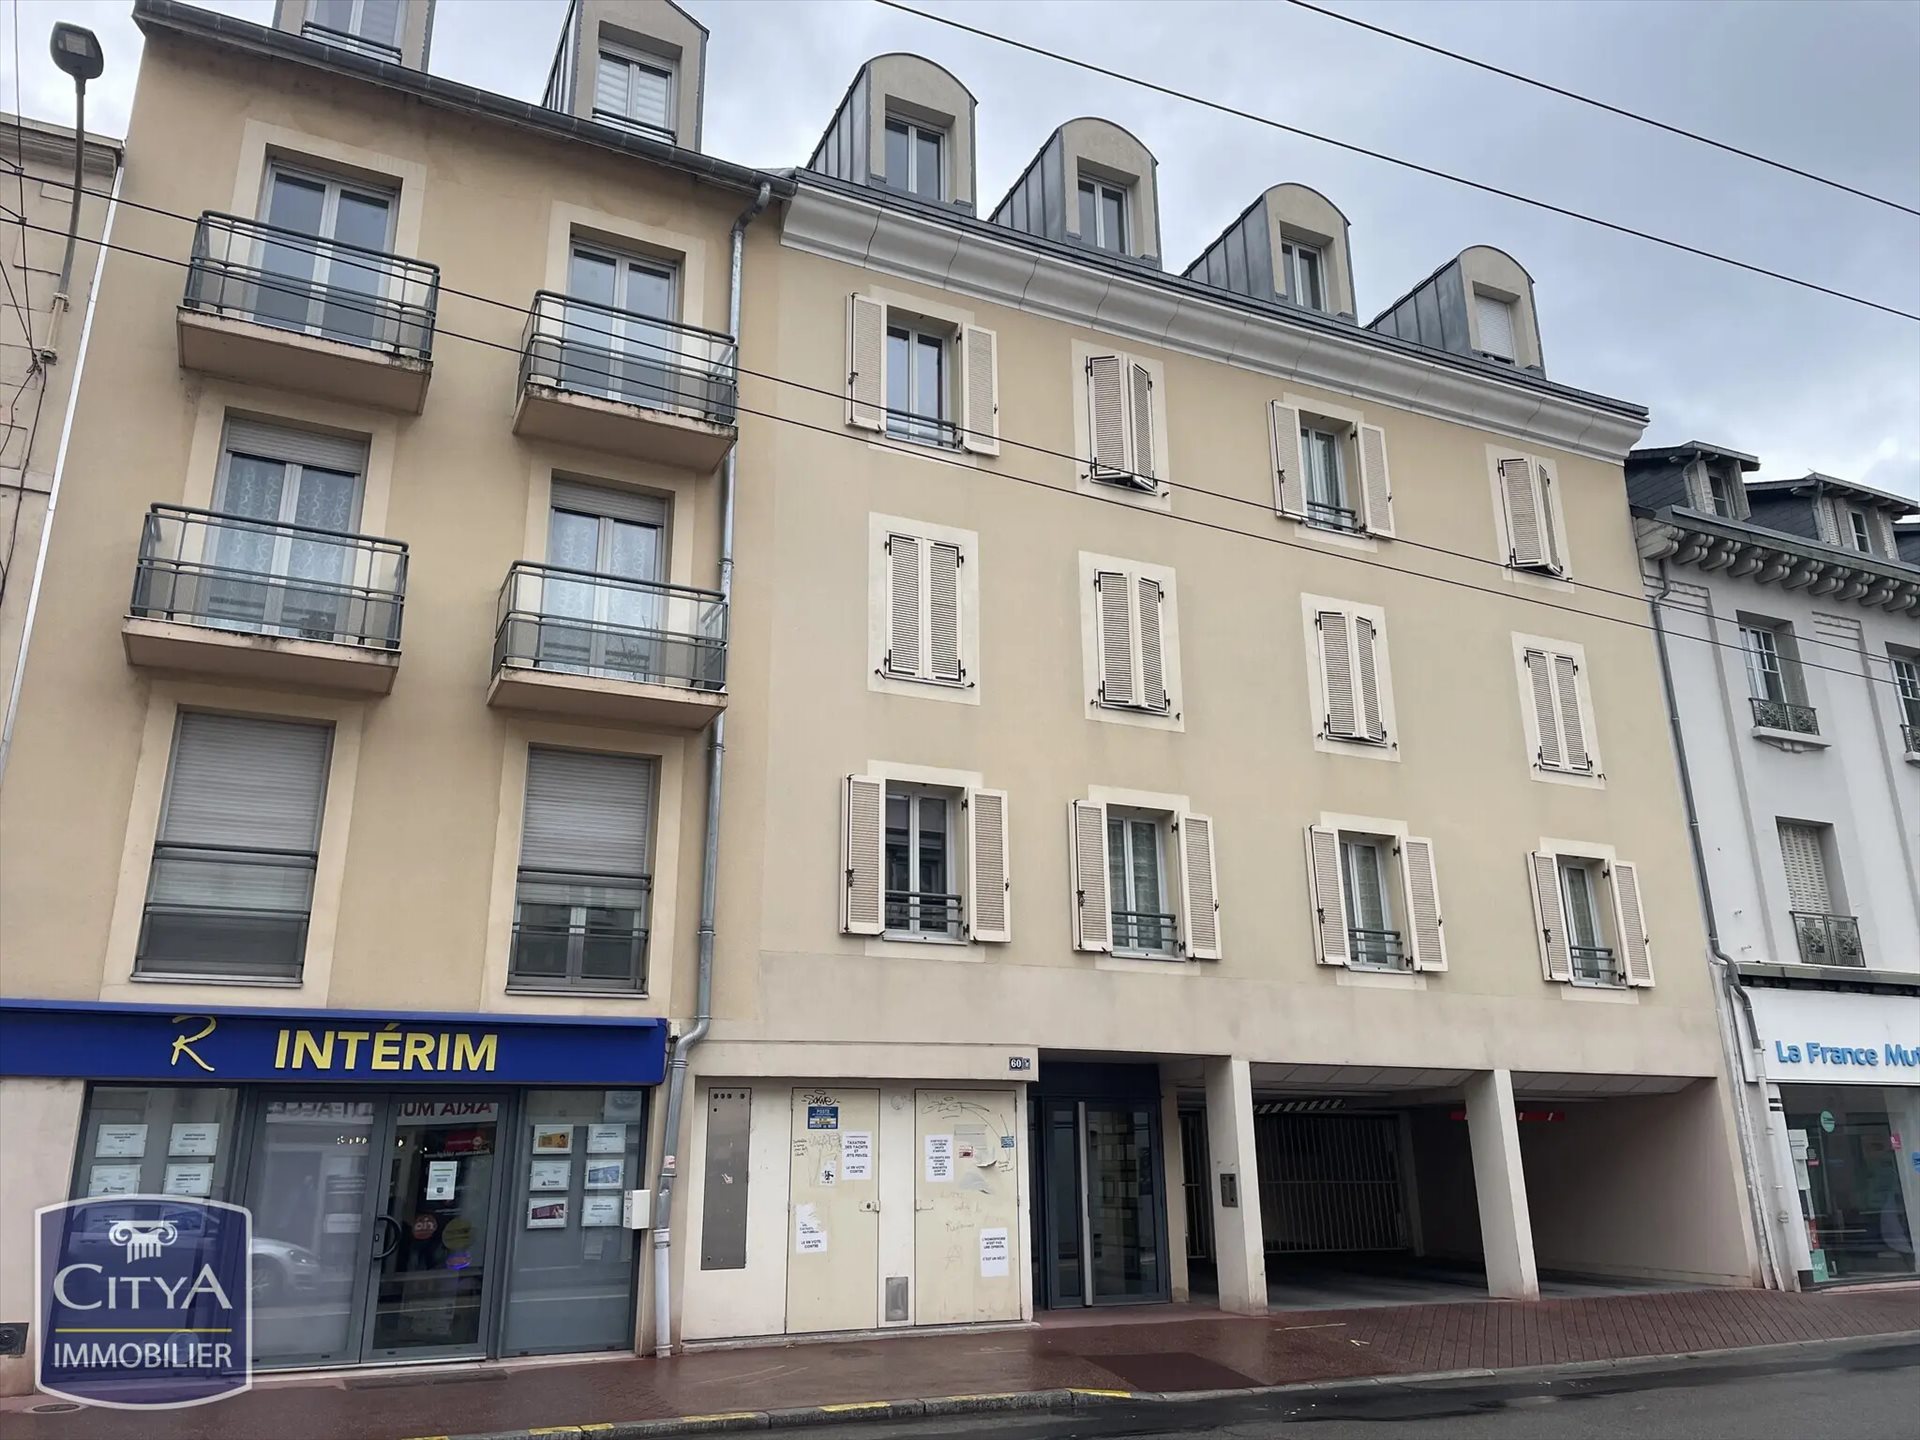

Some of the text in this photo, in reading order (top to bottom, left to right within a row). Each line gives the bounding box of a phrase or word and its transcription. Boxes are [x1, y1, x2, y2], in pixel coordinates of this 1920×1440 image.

[171, 1015, 498, 1072] R INTÉRIM
[1775, 1040, 1802, 1064] La
[1806, 1042, 1879, 1067] France
[1010, 1058, 1022, 1069] 60
